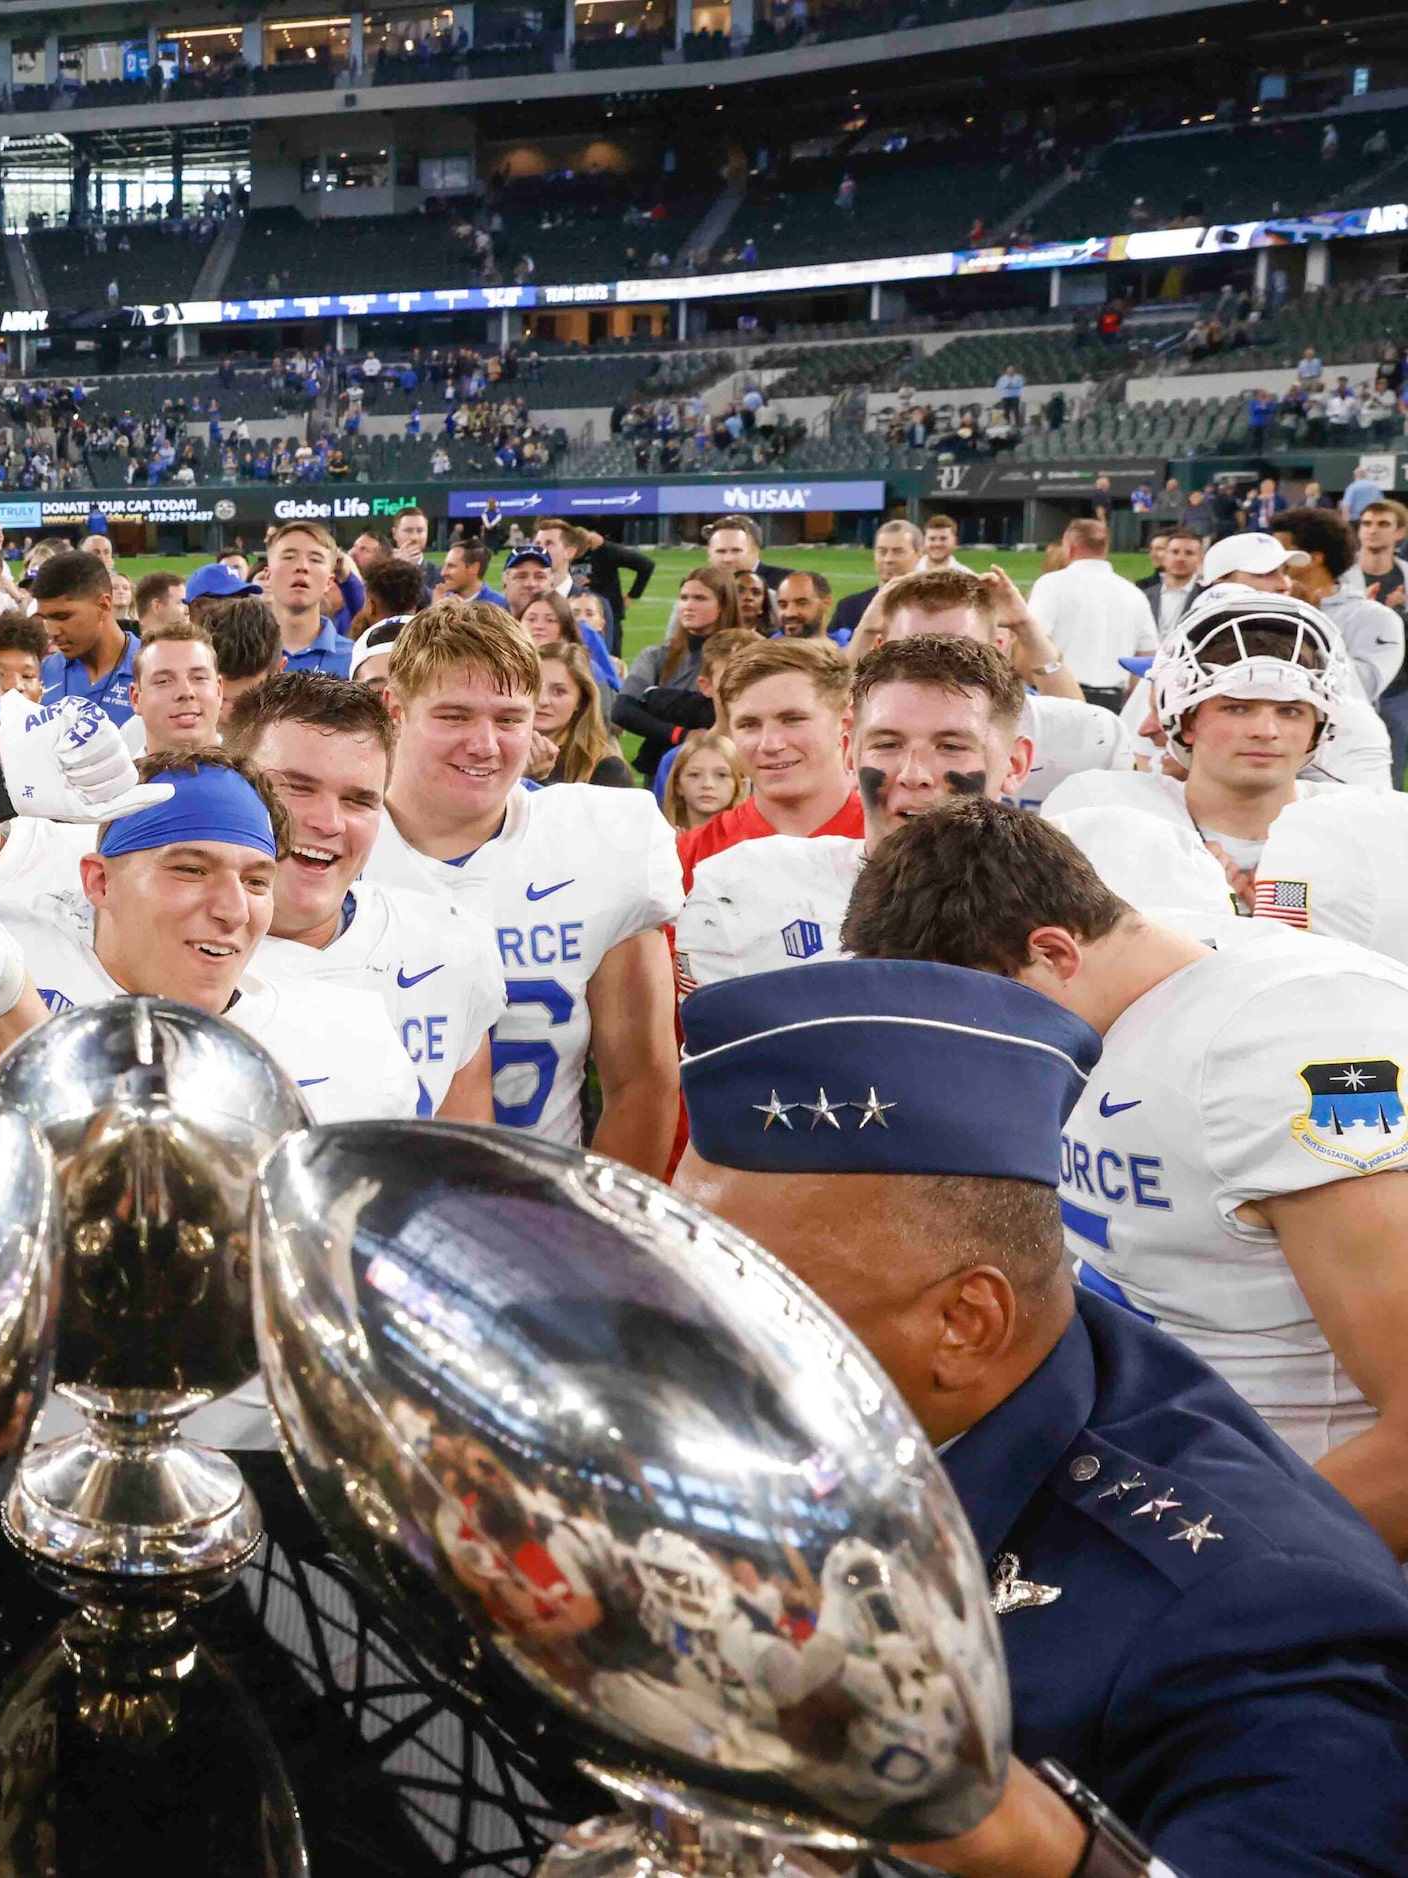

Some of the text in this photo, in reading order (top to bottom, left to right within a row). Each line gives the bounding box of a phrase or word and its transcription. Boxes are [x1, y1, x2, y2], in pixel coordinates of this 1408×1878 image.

[1365, 203, 1408, 234] AIR
[545, 284, 609, 302] TEAM STATS
[41, 501, 90, 514] DONATE
[126, 500, 152, 512] CAR
[152, 498, 197, 511] TODAY!
[274, 498, 332, 518] Globe
[333, 497, 370, 517] Life
[750, 490, 806, 509] USAA
[0, 507, 35, 518] TRULY
[110, 680, 128, 699] AF
[495, 920, 585, 968] RCE
[400, 1014, 449, 1063] CE
